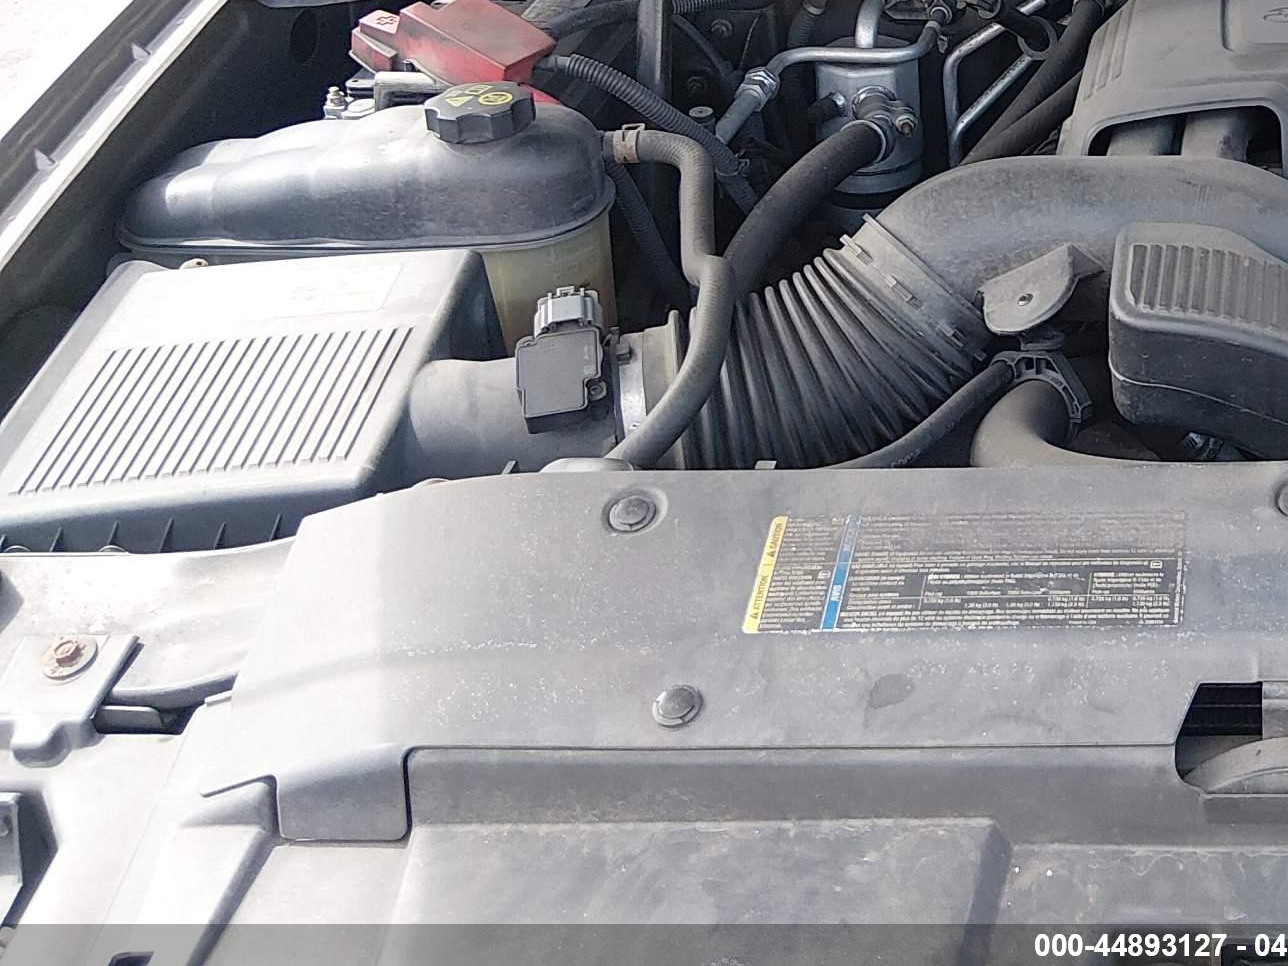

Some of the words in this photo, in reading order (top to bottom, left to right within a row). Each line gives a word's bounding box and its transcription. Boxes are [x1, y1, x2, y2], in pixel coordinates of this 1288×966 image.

[769, 522, 783, 549] CAUTION
[754, 574, 769, 610] ATTENTION
[829, 584, 842, 602] AVIS
